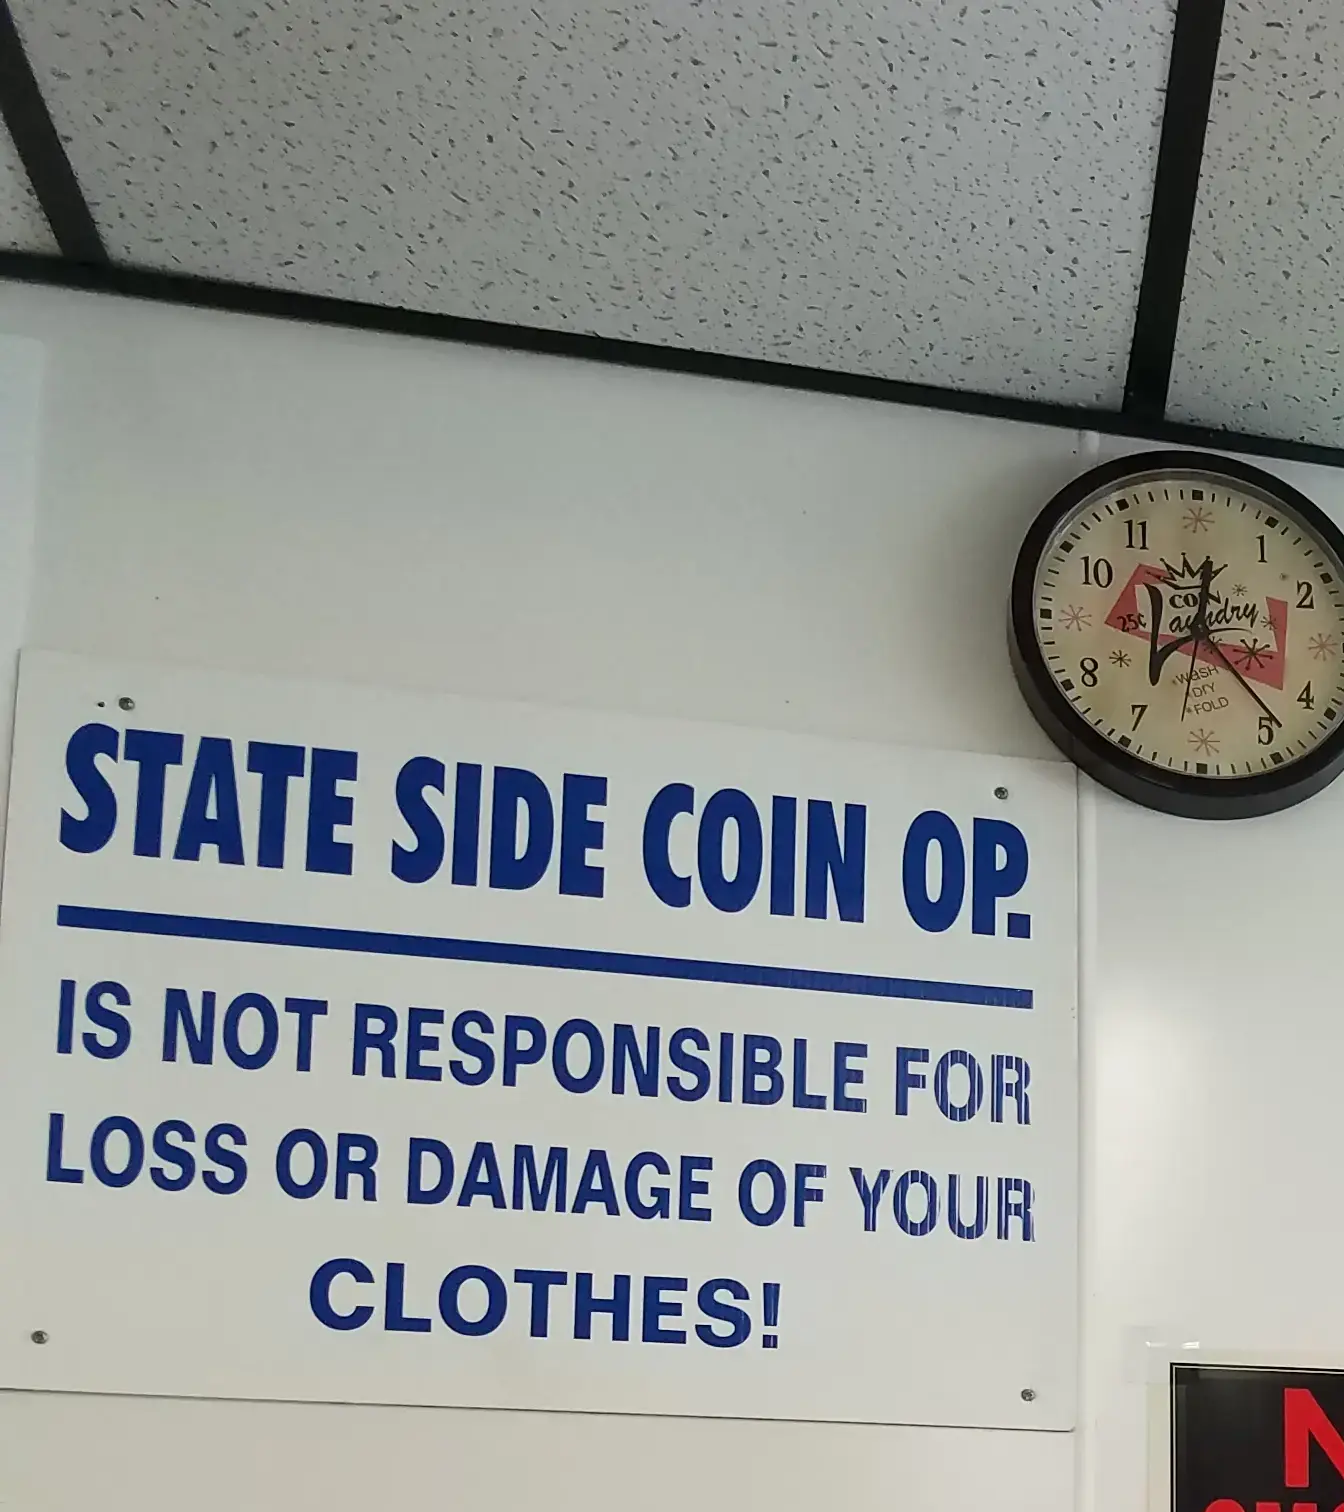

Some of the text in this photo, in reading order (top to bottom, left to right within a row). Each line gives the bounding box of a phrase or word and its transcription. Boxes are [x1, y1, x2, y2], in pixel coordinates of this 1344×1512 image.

[1123, 519, 1148, 550] 11
[1255, 535, 1268, 563] 1
[1081, 556, 1113, 588] 10
[1296, 581, 1314, 609] 2
[1079, 657, 1099, 687] 8
[1194, 697, 1229, 714] FOLD
[1297, 681, 1314, 709] 4
[1131, 704, 1148, 731] 7
[1257, 716, 1275, 745] 5
[58, 723, 1031, 939] STATE SIDE COIN OP.
[56, 978, 1032, 1126] IS NOT RESPONSIBLE FOR
[46, 1113, 1036, 1243] LOSS OR DAMAGE OF YOUR
[308, 1257, 781, 1349] CLOTHES!
